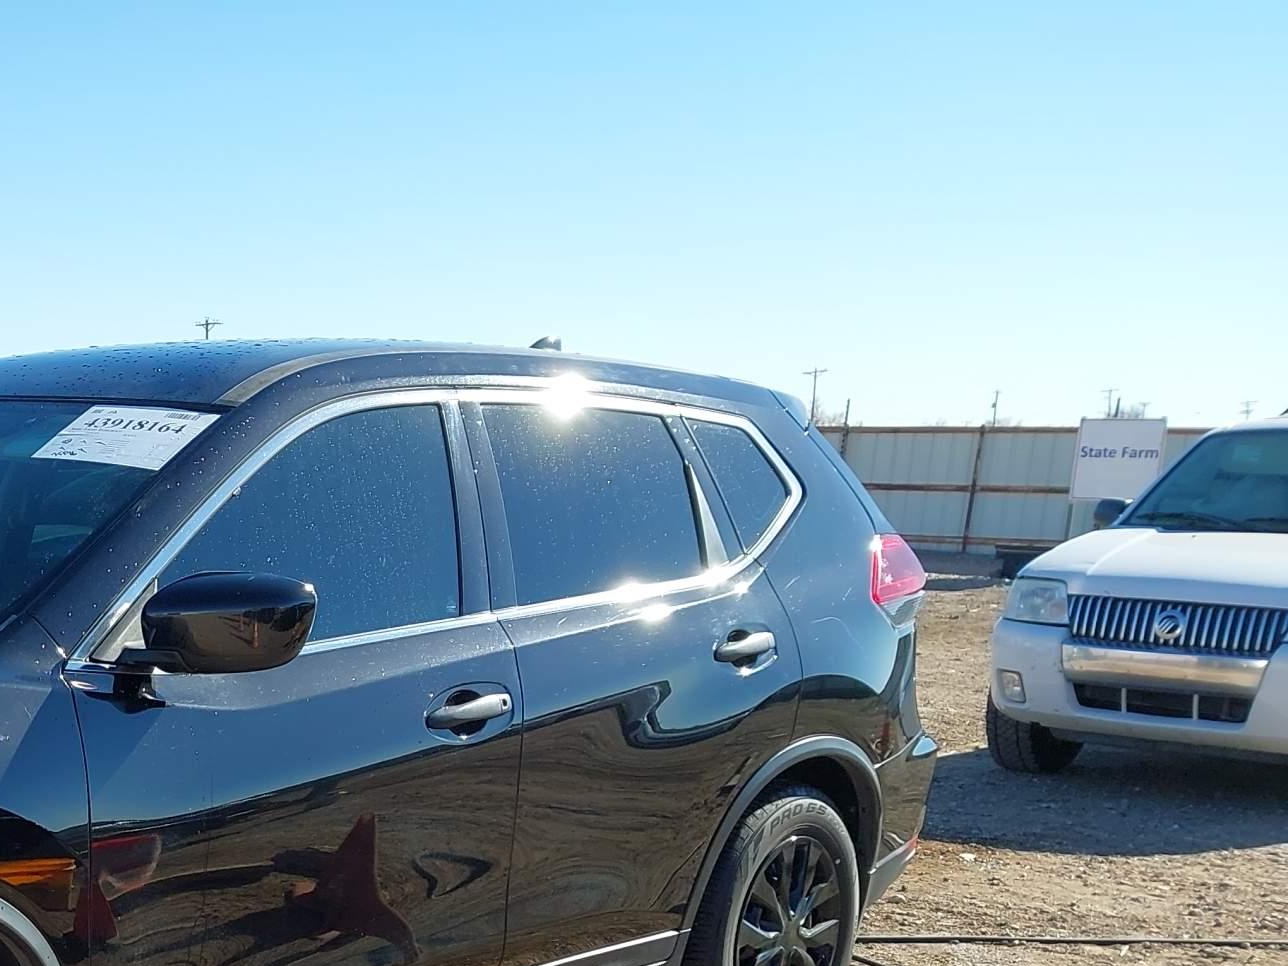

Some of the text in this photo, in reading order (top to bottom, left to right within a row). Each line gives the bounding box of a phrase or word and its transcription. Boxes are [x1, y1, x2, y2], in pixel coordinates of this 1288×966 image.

[84, 417, 187, 434] 43918164
[1080, 446, 1159, 458] State Farm
